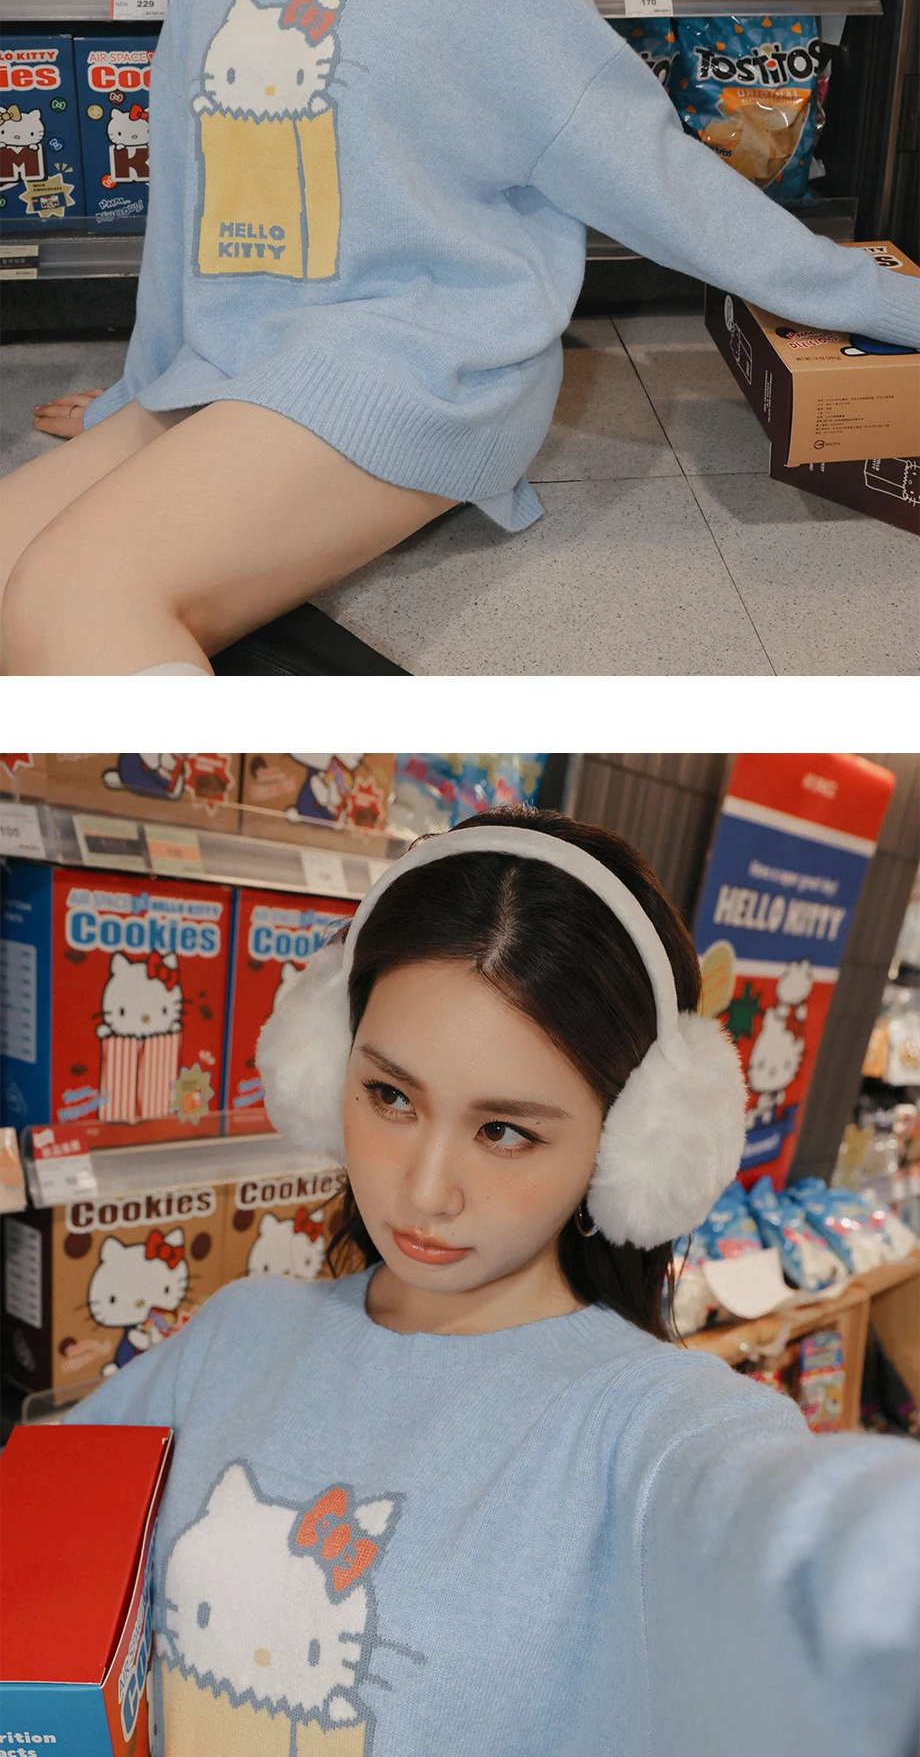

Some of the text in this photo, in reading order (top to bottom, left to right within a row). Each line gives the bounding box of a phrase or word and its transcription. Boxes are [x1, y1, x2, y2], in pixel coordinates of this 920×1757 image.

[219, 222, 285, 241] HELLO
[219, 242, 286, 260] KITTY
[713, 885, 847, 942] HELLO KITTY
[70, 911, 217, 953] Cookies
[239, 1172, 347, 1205] Cookies
[71, 1191, 213, 1229] Cookies
[0, 1731, 57, 1743] rition
